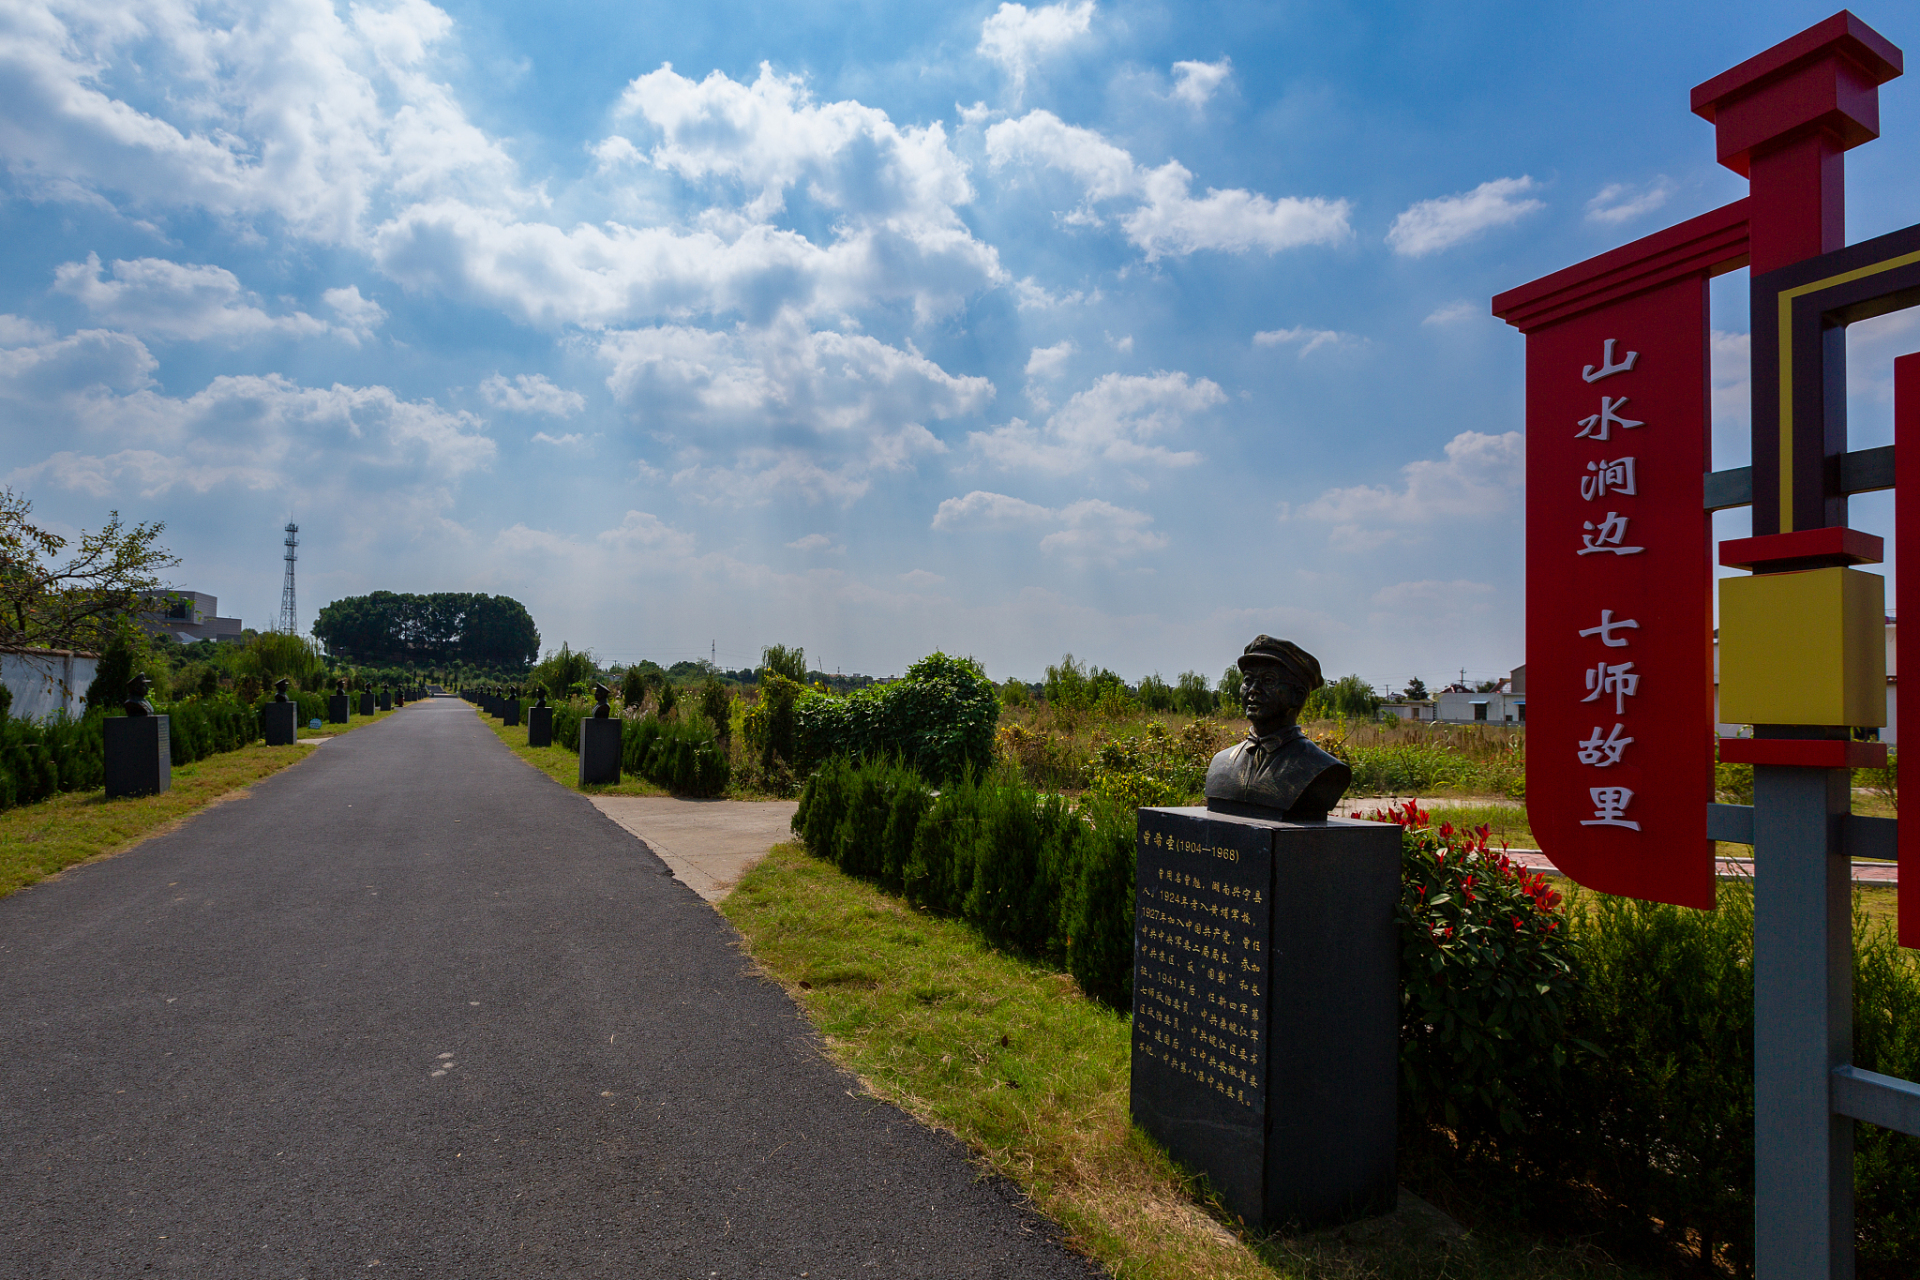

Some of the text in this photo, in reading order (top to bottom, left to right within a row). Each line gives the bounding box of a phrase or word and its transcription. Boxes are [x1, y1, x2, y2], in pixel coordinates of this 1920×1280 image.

[1575, 338, 1647, 832] 山水涧边 七师故里
